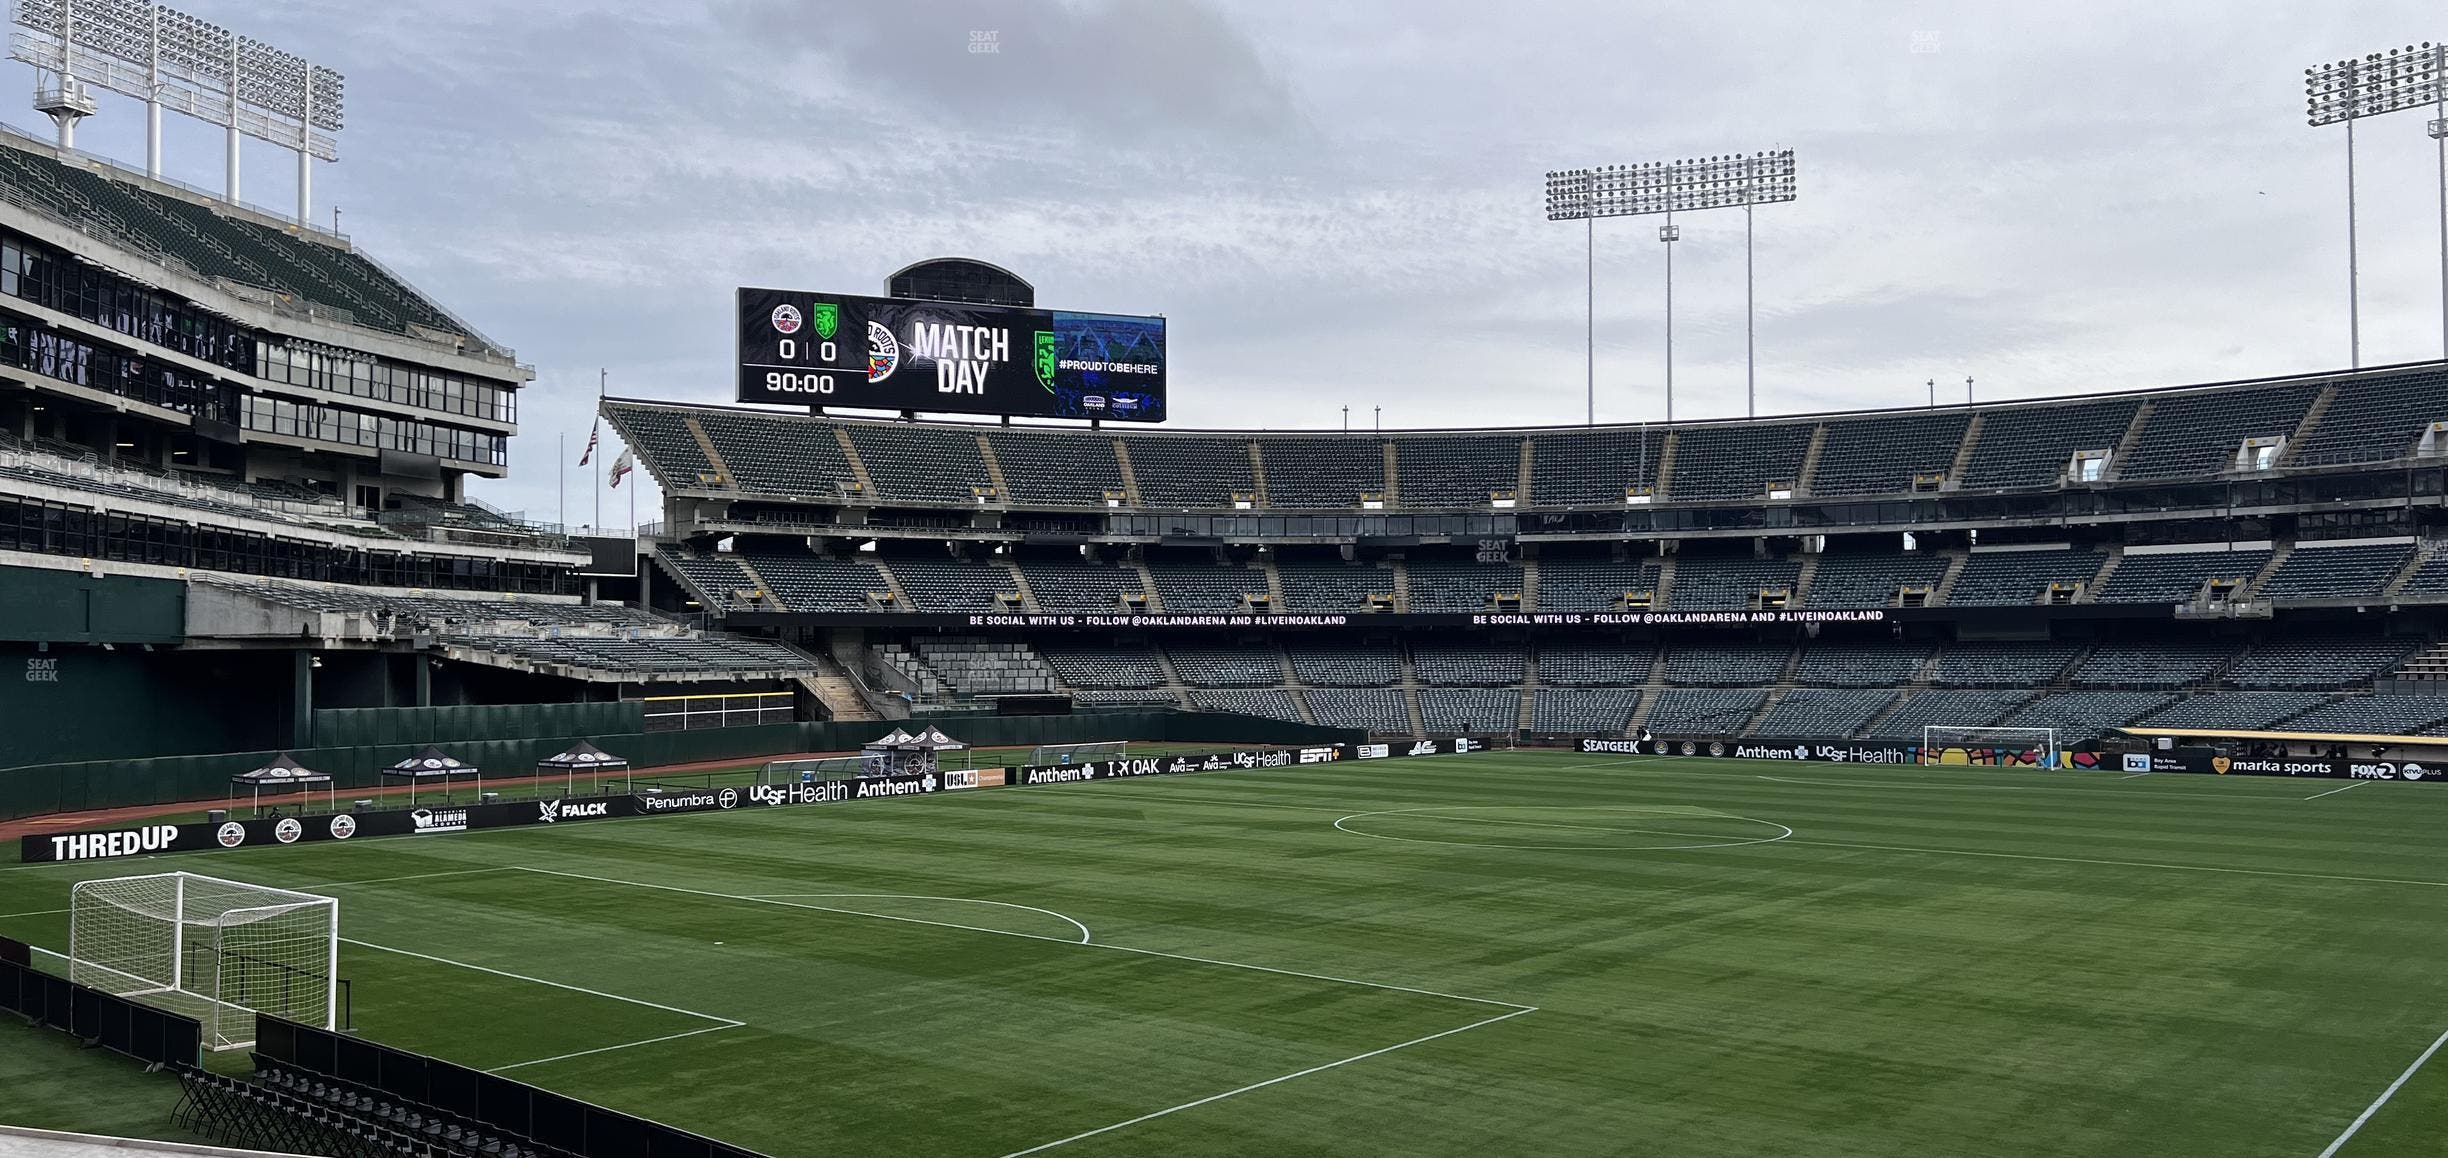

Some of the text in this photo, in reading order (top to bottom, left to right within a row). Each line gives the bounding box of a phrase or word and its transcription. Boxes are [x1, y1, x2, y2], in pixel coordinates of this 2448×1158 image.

[874, 328, 896, 355] ROOTS
[914, 321, 1009, 362] MATCH
[780, 339, 836, 361] 0 0
[1058, 359, 1158, 374] #PROUDTOBEHERE
[766, 372, 834, 394] 90:00
[937, 358, 989, 395] DAY
[969, 615, 983, 625] BE
[986, 615, 1026, 625] SOCIAL
[1029, 615, 1057, 625] WITH
[1060, 615, 1075, 625] US
[1086, 615, 1129, 625] FOLLOW
[1132, 615, 1227, 626] @OAKLANDARENA
[1230, 615, 1251, 625] AND
[1255, 615, 1346, 625] #LIVEINOAKLAND
[1473, 615, 1487, 624] BE
[1490, 615, 1530, 624] SOCIAL
[1534, 614, 1563, 624] WITH
[1566, 614, 1581, 623] US
[1593, 614, 1640, 623] FOLLOW
[1643, 612, 1748, 624] @OAKLANDARENA
[1751, 612, 1776, 622] AND
[1779, 610, 1884, 622] #LIVEINOAKLAND
[1583, 739, 1640, 754] SEATGEEK
[1735, 745, 1792, 760] Anthem
[1815, 745, 1904, 764] UCSF Health
[1132, 758, 1160, 775] OAK
[1202, 760, 1219, 770] Ava
[1233, 752, 1255, 768] UCSF
[1255, 749, 1291, 767] Health
[1028, 767, 1080, 784] Anthem
[1169, 762, 1186, 773] Ava
[2233, 760, 2280, 772] marka
[2284, 761, 2332, 775] sports
[2350, 764, 2378, 775] FOX
[749, 780, 848, 805] UCSF Health
[856, 778, 920, 798] Anthem
[562, 803, 607, 817] FALCK
[646, 794, 715, 810] Penumbra
[434, 812, 467, 823] ALAMEDA
[51, 825, 178, 861] THREDUP
